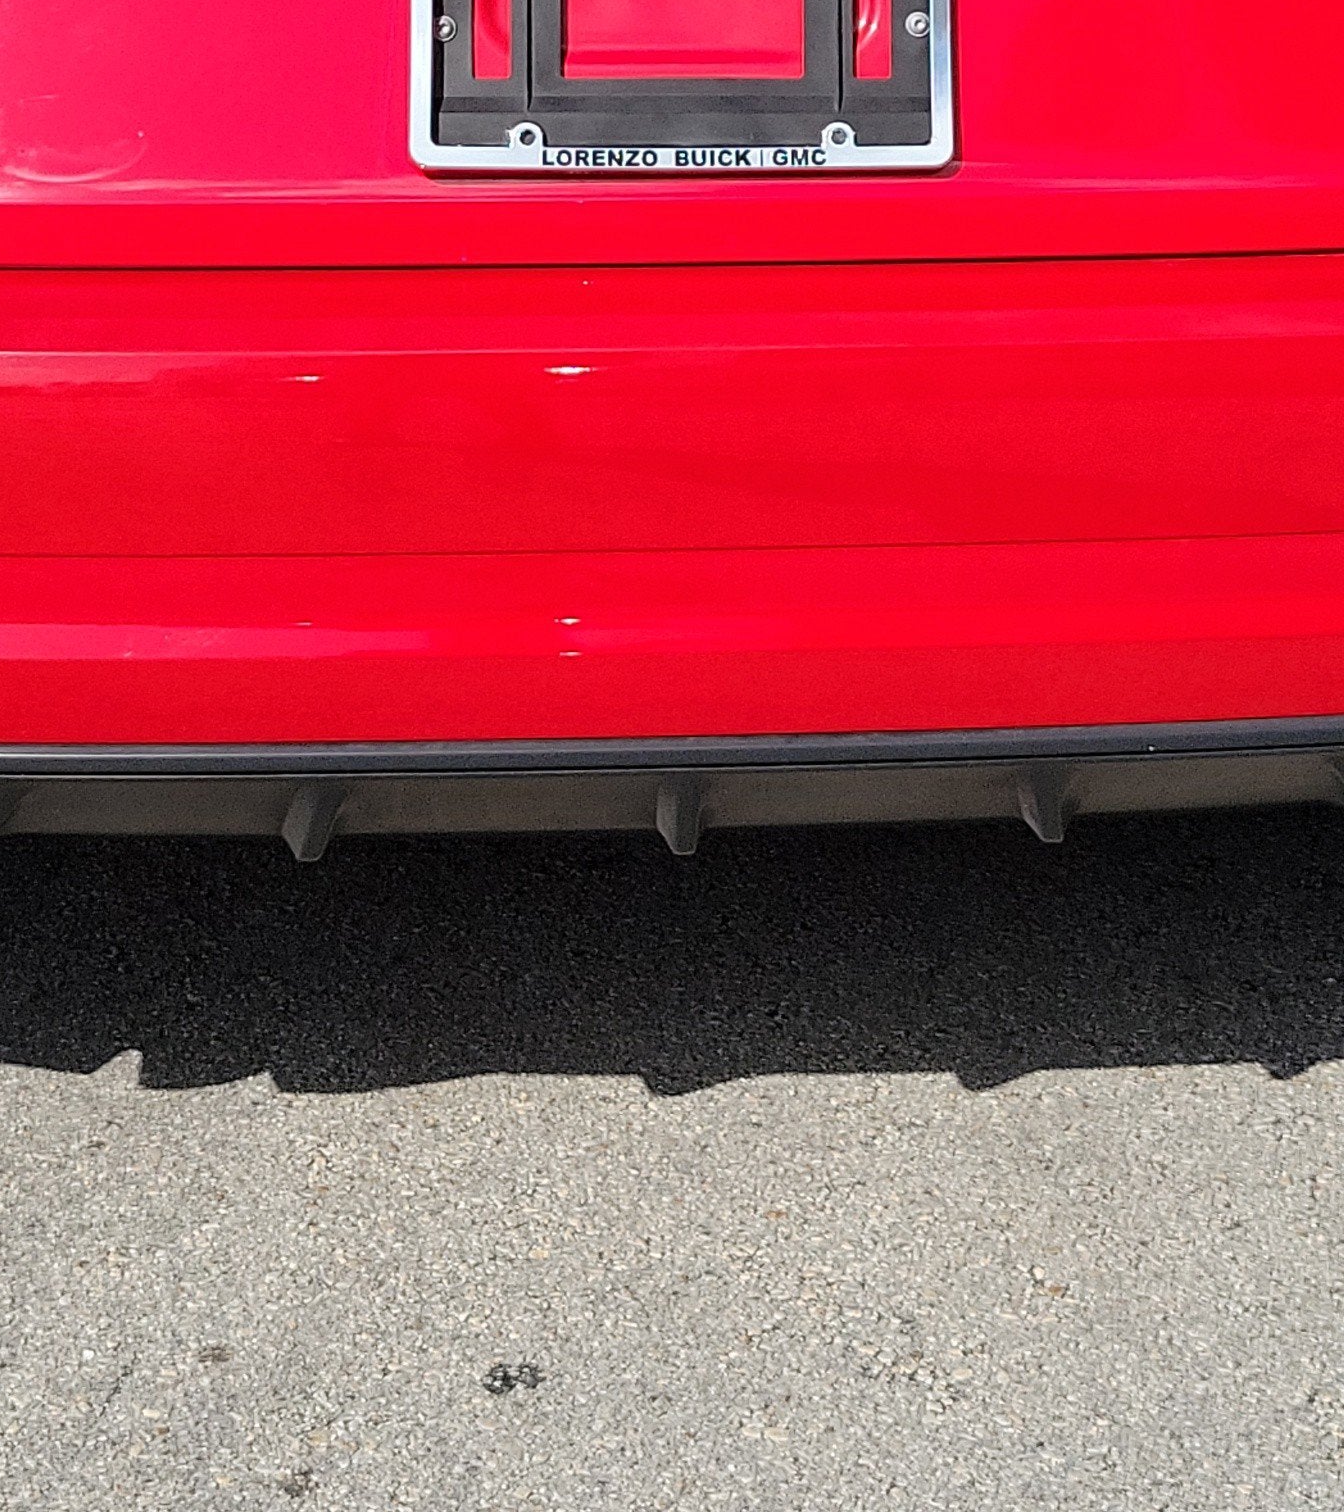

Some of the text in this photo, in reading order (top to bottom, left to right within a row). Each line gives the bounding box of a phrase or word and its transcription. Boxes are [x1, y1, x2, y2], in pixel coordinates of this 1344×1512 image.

[542, 148, 827, 166] LORENZO BUICK GMC
